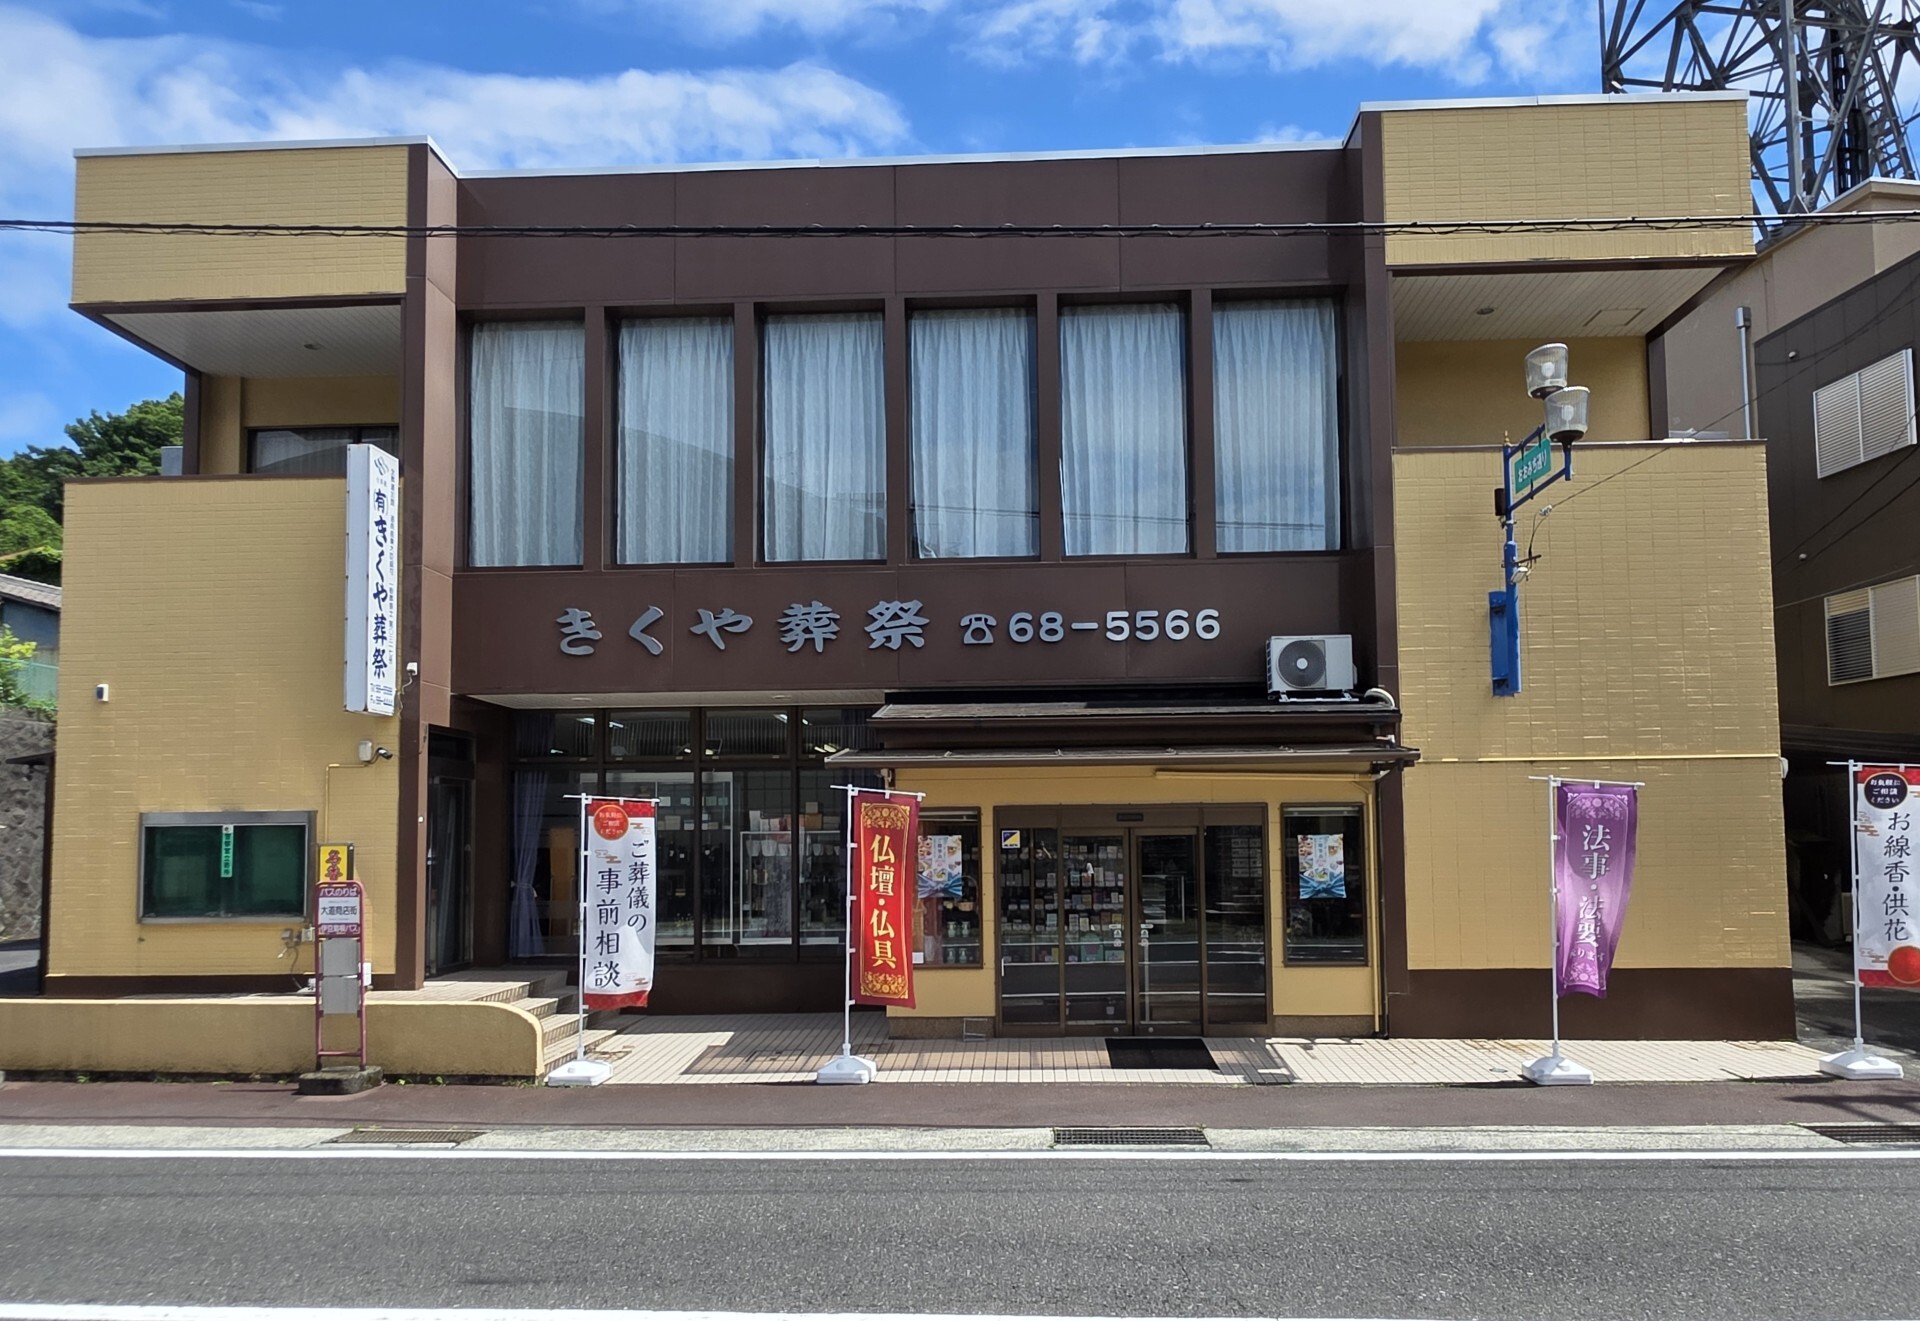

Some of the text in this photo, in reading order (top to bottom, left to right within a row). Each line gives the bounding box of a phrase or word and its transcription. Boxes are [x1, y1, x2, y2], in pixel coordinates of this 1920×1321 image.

[555, 600, 1221, 656] きくや葬祭 68-5566
[1871, 796, 1900, 804] ください
[1872, 787, 1898, 795] ご相談
[320, 887, 357, 896] バスのりば
[626, 839, 650, 933] ご葬儀の
[869, 834, 897, 969] 仏壇・仏具
[1576, 824, 1612, 948] 法事・法要
[1882, 812, 1912, 942] お線香・供花
[593, 867, 623, 989] 事前相談
